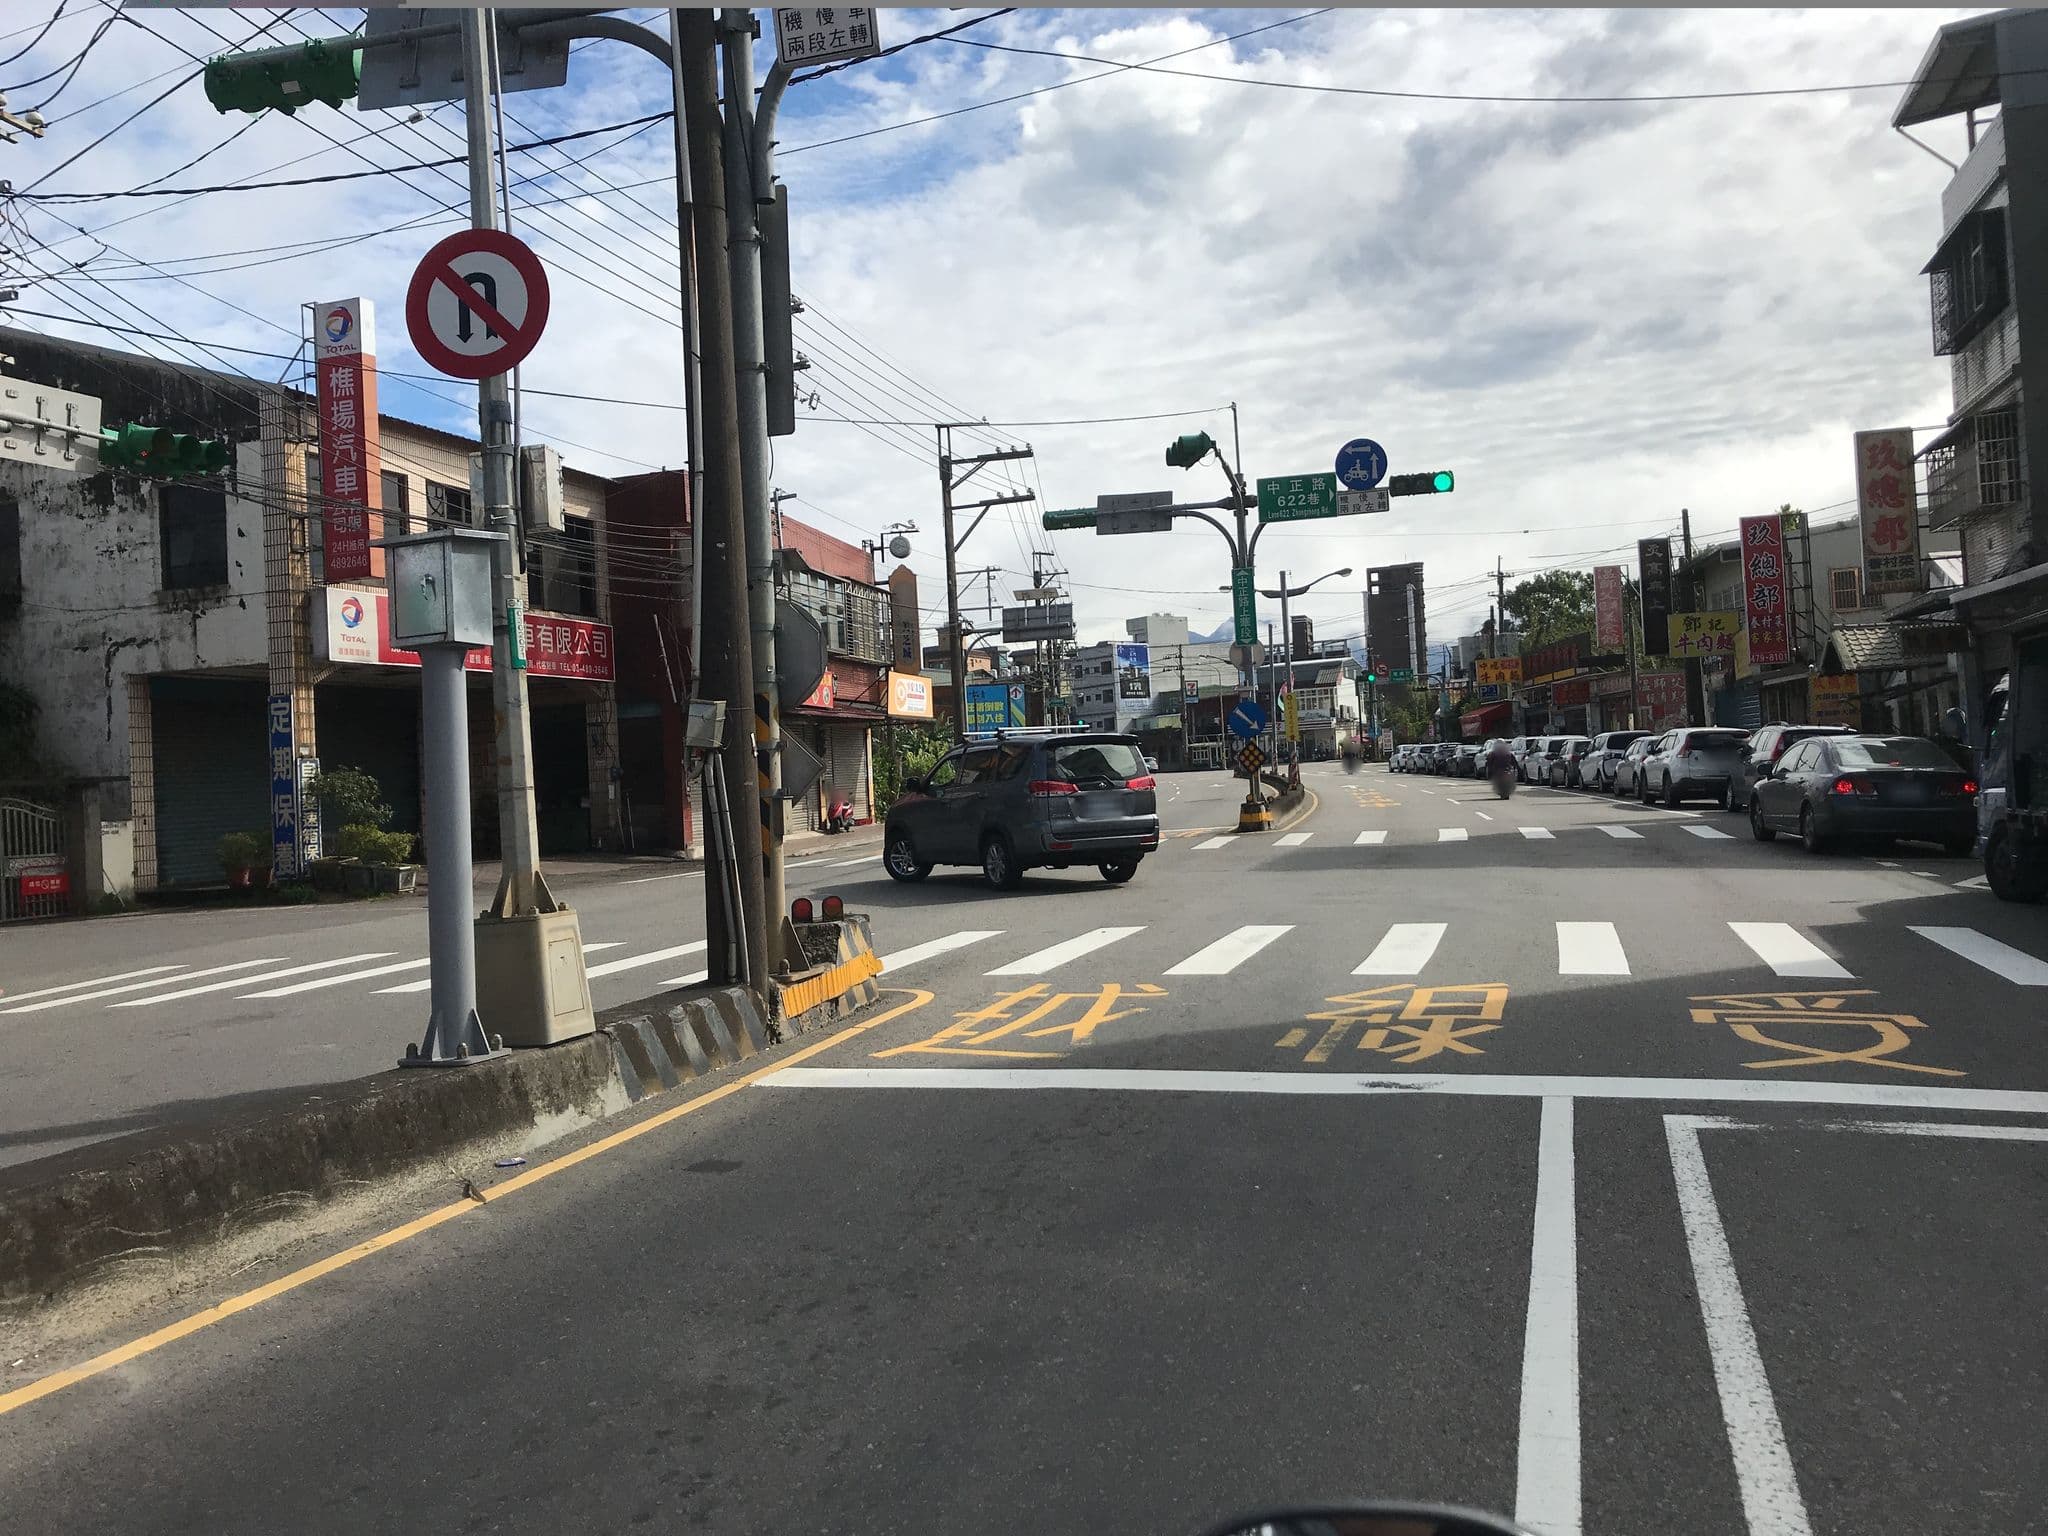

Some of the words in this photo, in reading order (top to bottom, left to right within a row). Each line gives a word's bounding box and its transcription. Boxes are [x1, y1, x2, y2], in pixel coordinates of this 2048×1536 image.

[784, 8, 866, 32] 機慢車
[787, 24, 867, 57] 兩段左轉
[326, 343, 357, 354] TOTAL
[1267, 477, 1327, 495] 中正路
[1866, 438, 1908, 551] 玖總部
[1278, 493, 1321, 507] 622巷
[330, 555, 368, 569] 4892646
[1747, 521, 1781, 614] 玖總部
[1682, 615, 1726, 633] 鄧記
[340, 634, 366, 644] TOTAL
[1674, 631, 1735, 655] 牛肉麵
[270, 699, 295, 879] 定期保養
